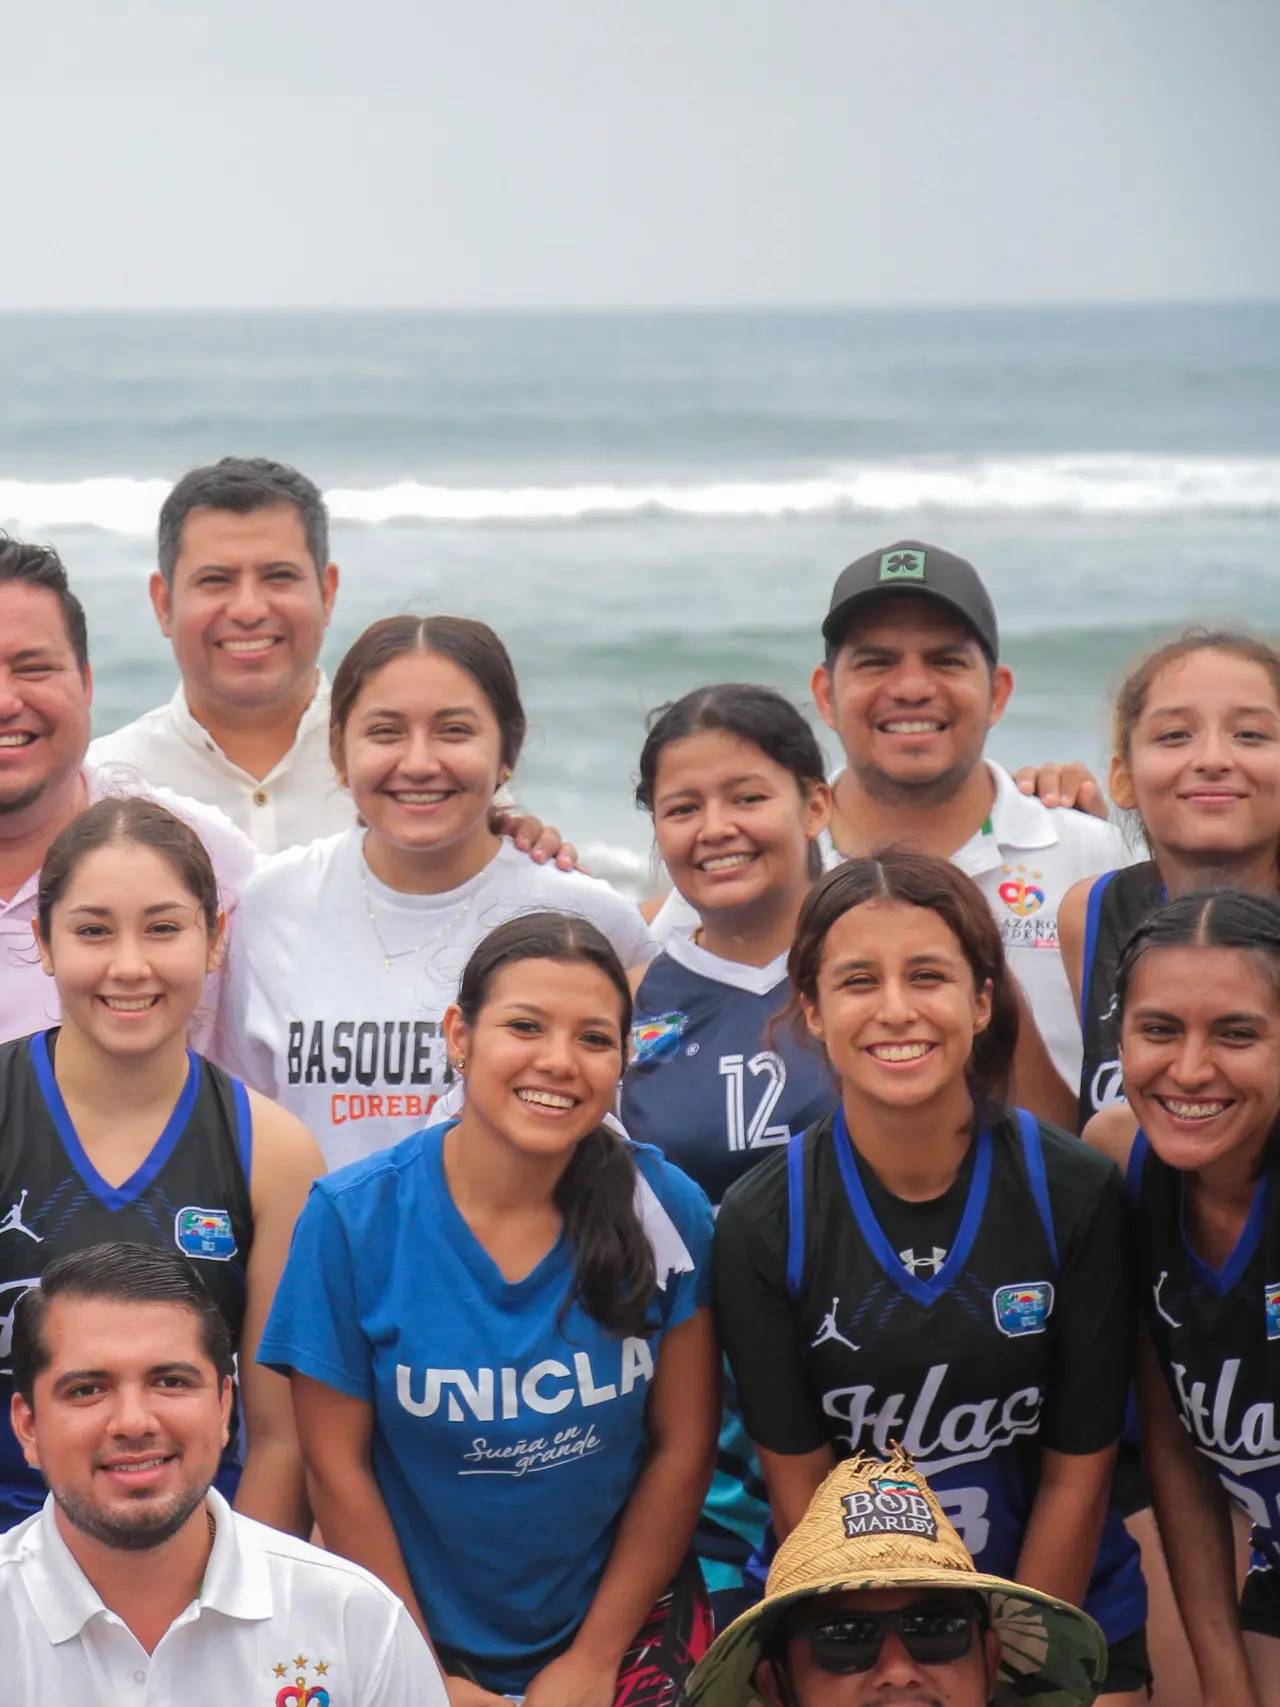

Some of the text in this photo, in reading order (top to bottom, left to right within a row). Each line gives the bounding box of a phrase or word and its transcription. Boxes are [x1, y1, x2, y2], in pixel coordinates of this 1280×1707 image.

[719, 1051, 790, 1151] 12
[396, 1336, 655, 1422] UNICLA
[464, 1424, 582, 1462] Sueña en
[512, 1424, 601, 1477] grande
[843, 1492, 933, 1520] BOB
[847, 1515, 935, 1536] MARLEY
